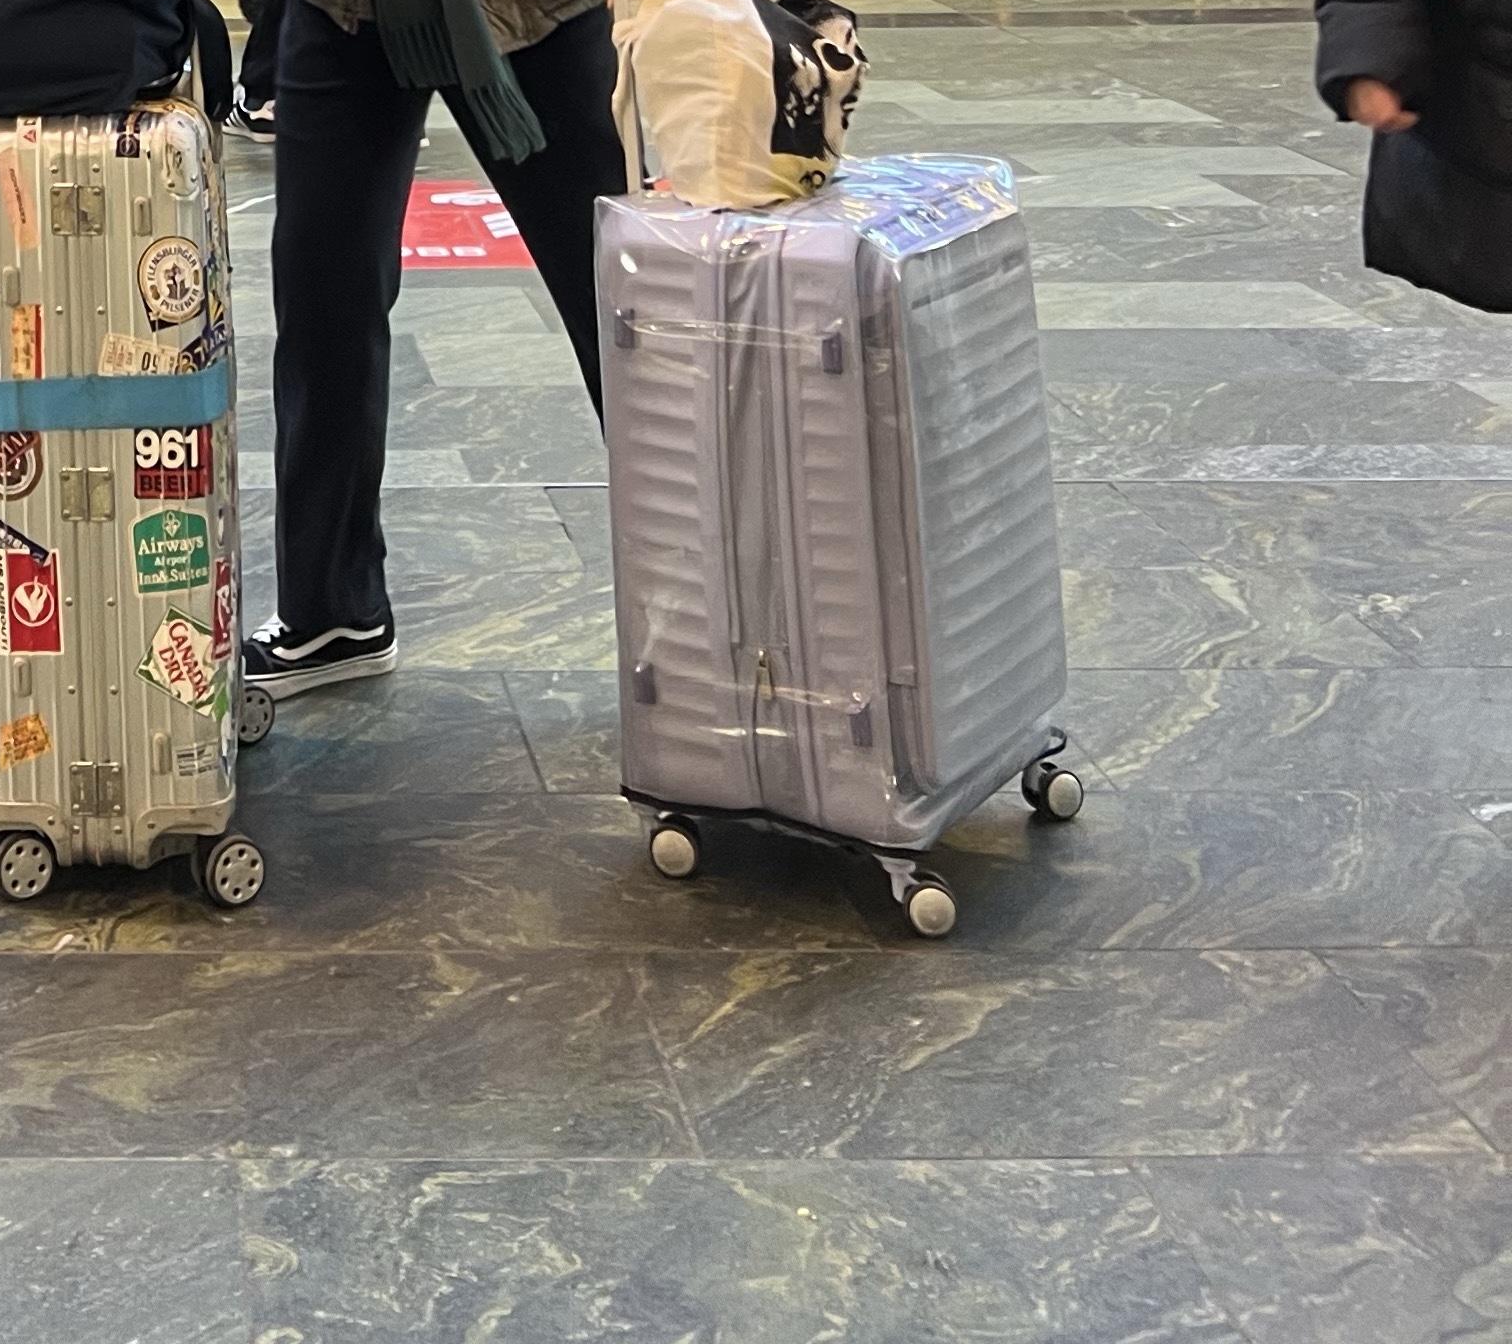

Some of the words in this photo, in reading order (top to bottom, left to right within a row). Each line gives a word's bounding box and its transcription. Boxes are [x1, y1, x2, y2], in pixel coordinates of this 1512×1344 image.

[136, 429, 199, 469] 961
[140, 474, 193, 493] BEER
[138, 535, 205, 556] Airways
[158, 646, 186, 684] DRY
[169, 621, 209, 699] CANADA
